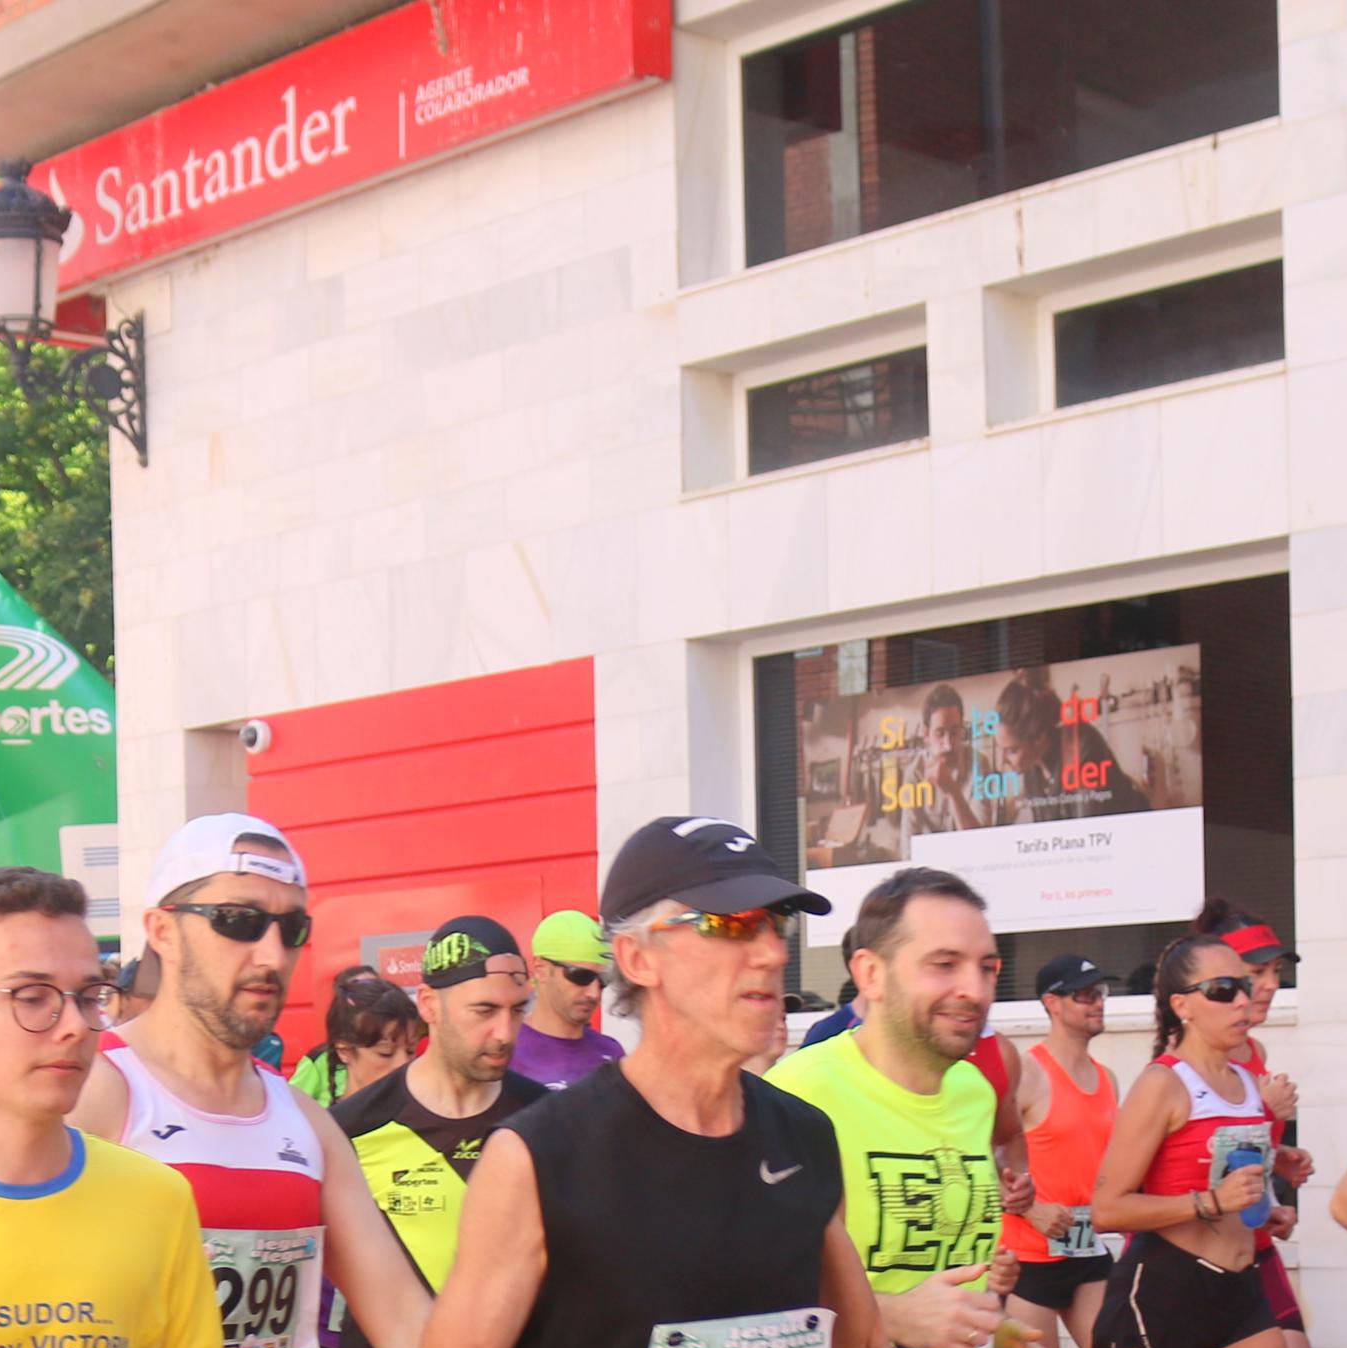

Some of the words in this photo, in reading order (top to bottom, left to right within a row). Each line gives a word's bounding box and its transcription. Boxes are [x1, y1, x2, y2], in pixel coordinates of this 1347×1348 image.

[415, 65, 473, 104] AGENTE
[415, 66, 530, 126] COLABORADOR
[94, 85, 357, 246] Santander
[880, 717, 905, 750] Si
[972, 705, 1000, 738] te
[1060, 690, 1099, 725] da
[881, 778, 933, 812] San
[972, 768, 1020, 801] tan
[1062, 754, 1112, 791] der
[1016, 839, 1049, 854] Tarifa
[1052, 836, 1085, 851] Plana
[1088, 832, 1113, 847] TPV
[212, 1265, 298, 1341] 299
